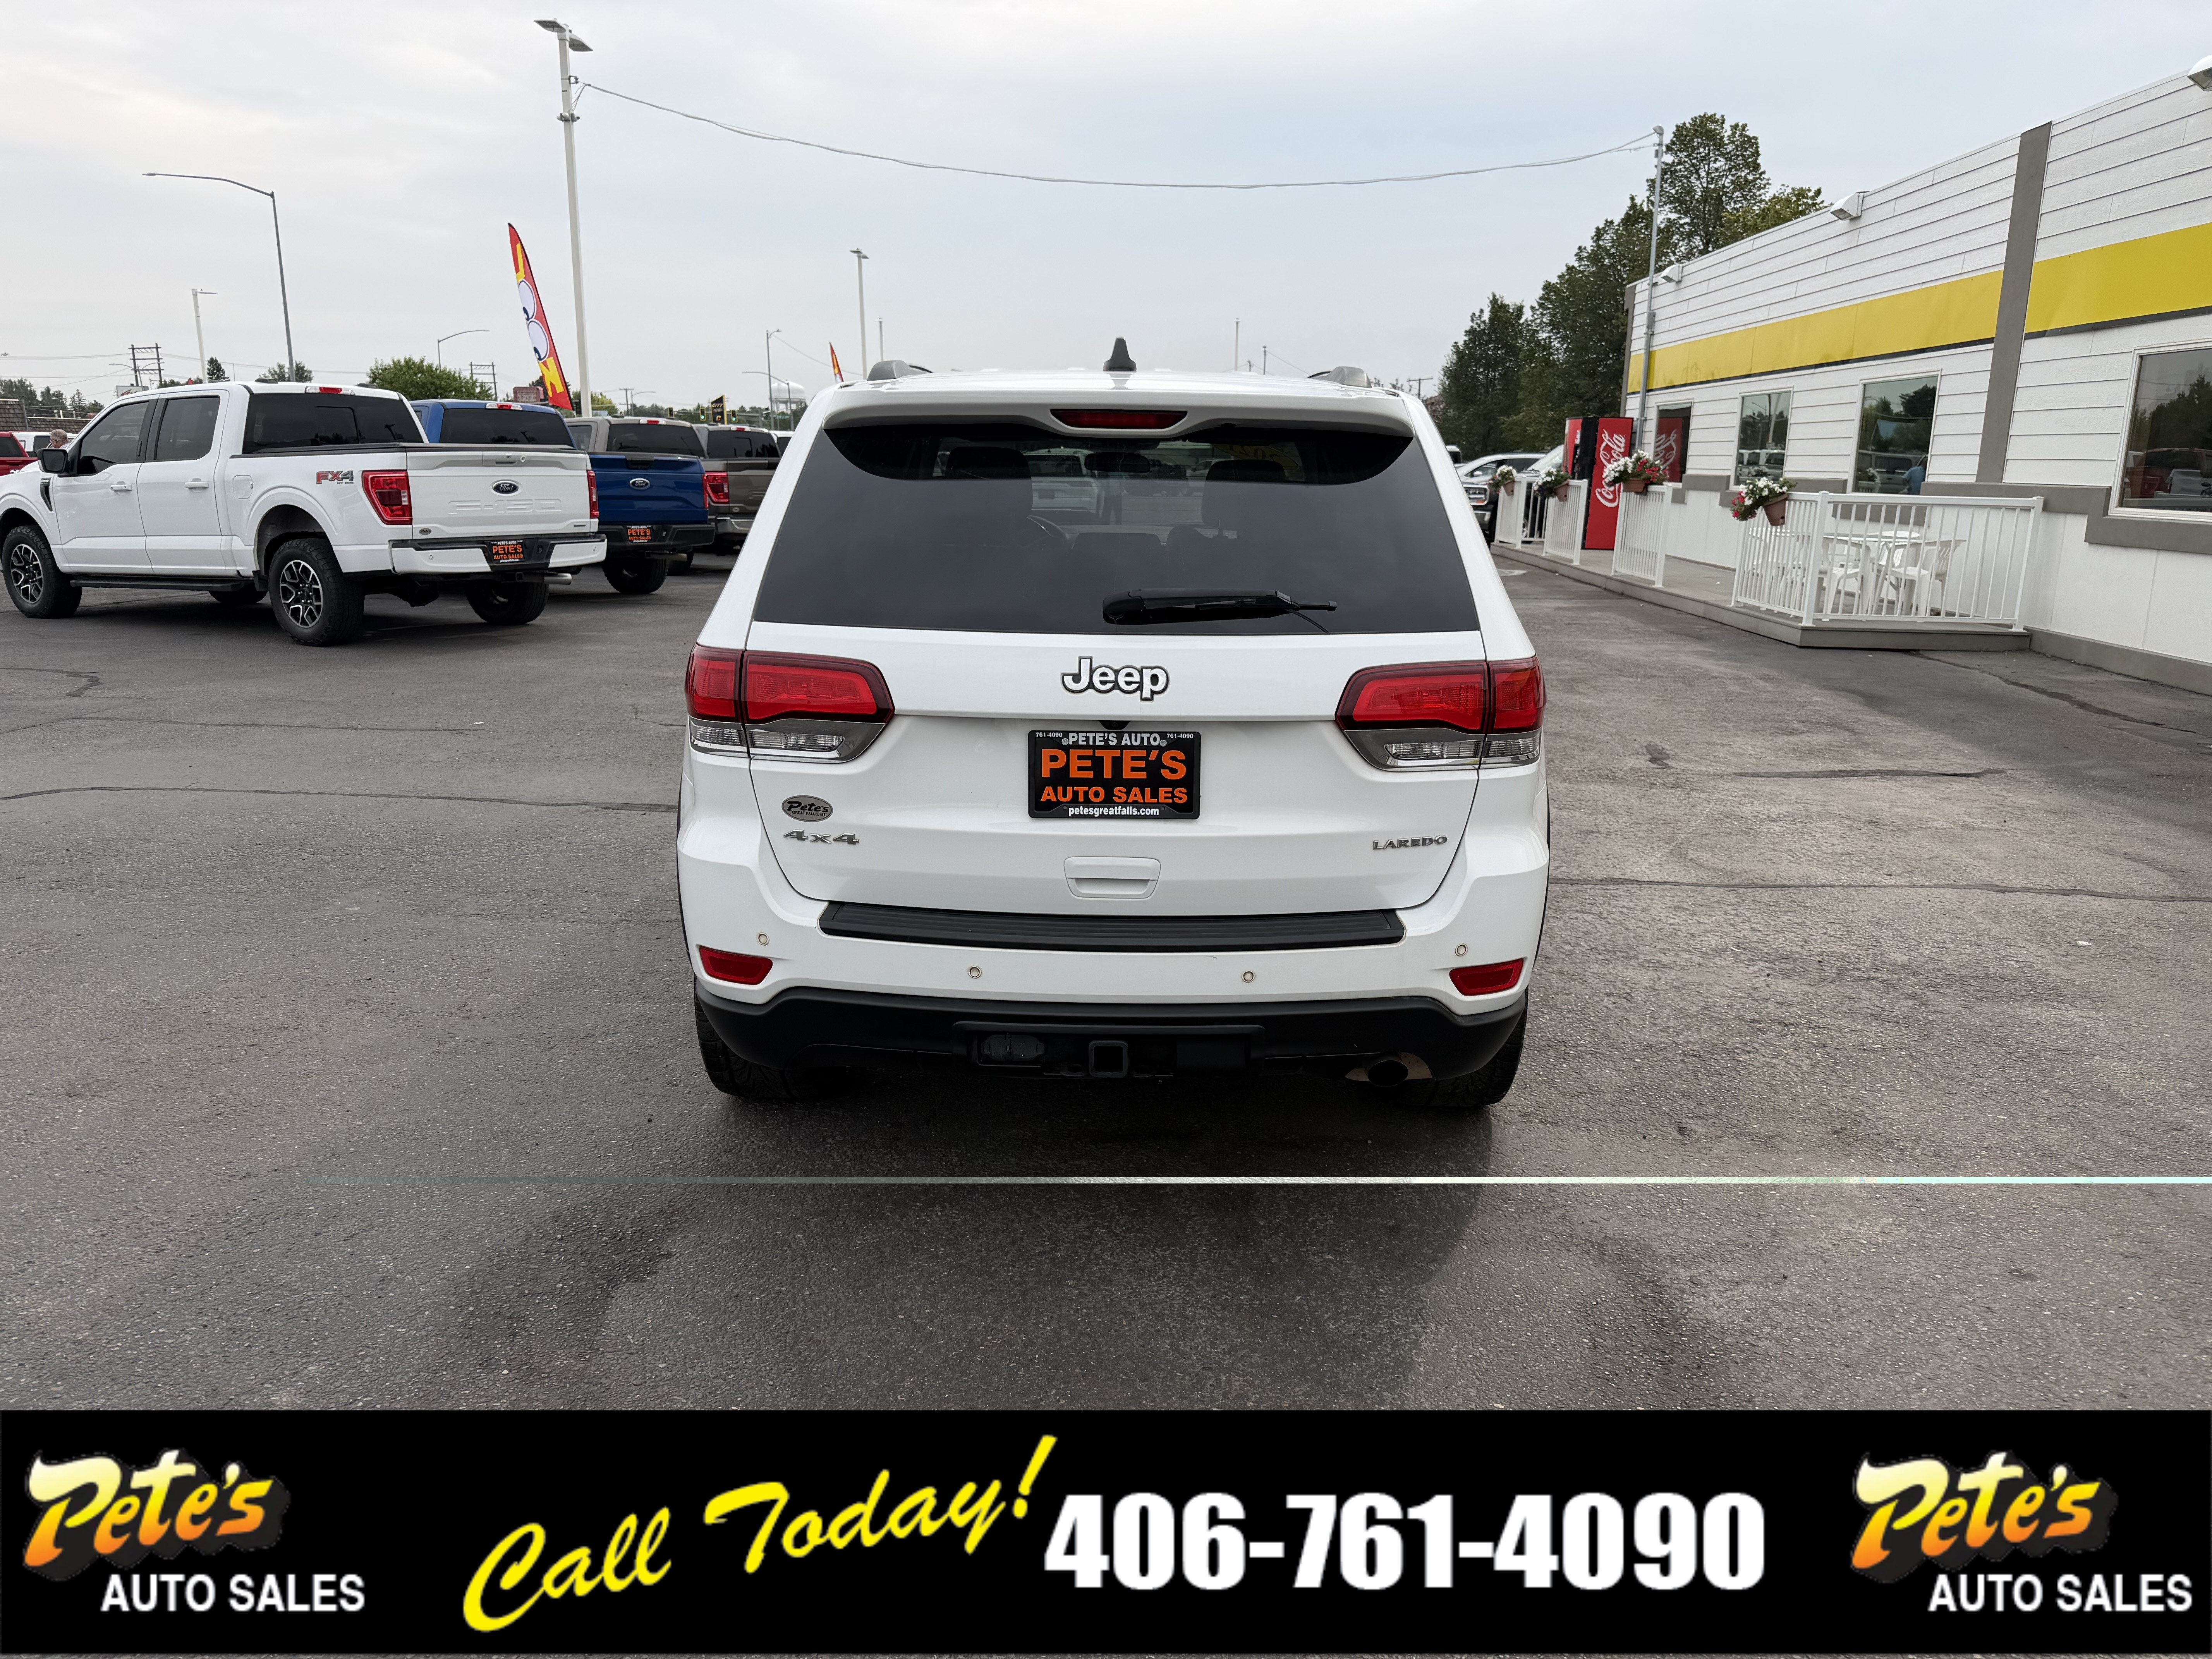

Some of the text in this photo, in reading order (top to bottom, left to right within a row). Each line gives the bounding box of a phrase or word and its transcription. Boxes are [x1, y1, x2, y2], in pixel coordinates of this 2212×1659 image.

[316, 471, 354, 484] FX4
[493, 544, 522, 553] PETE'S
[1061, 656, 1169, 701] Jeep
[1069, 733, 1160, 746] PETE'S AUTO
[1042, 749, 1186, 780] PETE'S
[1041, 786, 1188, 803] AUTO SALES
[787, 801, 829, 812] Pete's
[1069, 805, 1159, 817] petesgreatfalls.com
[1373, 835, 1448, 850] LAREDO
